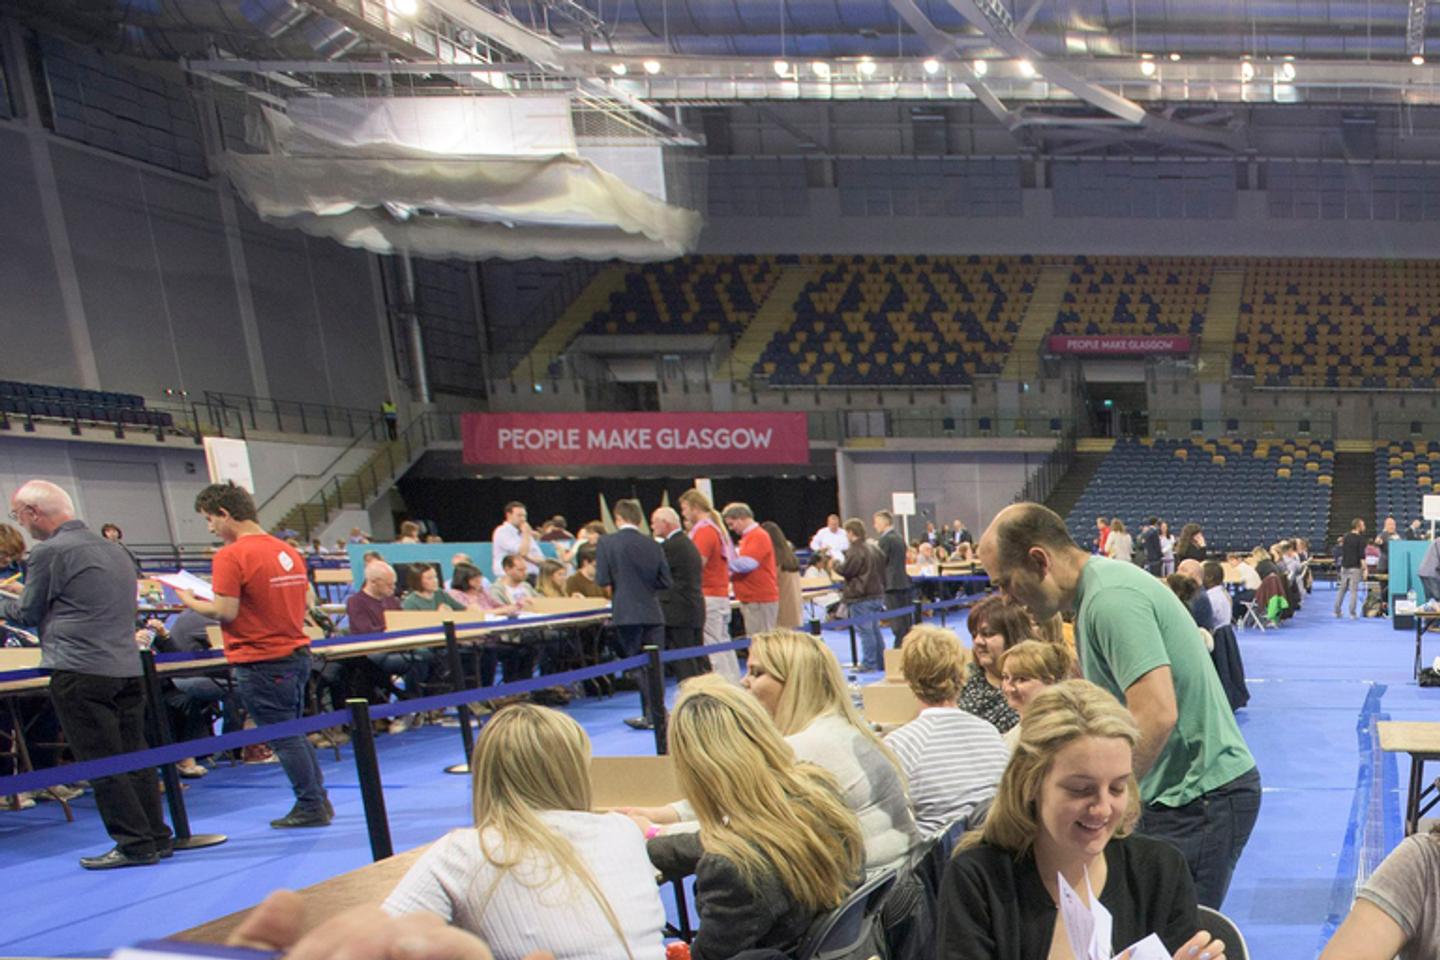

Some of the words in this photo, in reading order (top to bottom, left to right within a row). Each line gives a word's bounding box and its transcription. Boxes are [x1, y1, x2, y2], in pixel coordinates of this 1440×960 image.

[1066, 339, 1098, 350] PEOPLE
[1101, 339, 1127, 349] MAKE
[1127, 339, 1173, 350] GLASGOW
[497, 427, 580, 450] PEOPLE
[587, 427, 652, 450] MAKE
[656, 427, 773, 450] GLASGOW
